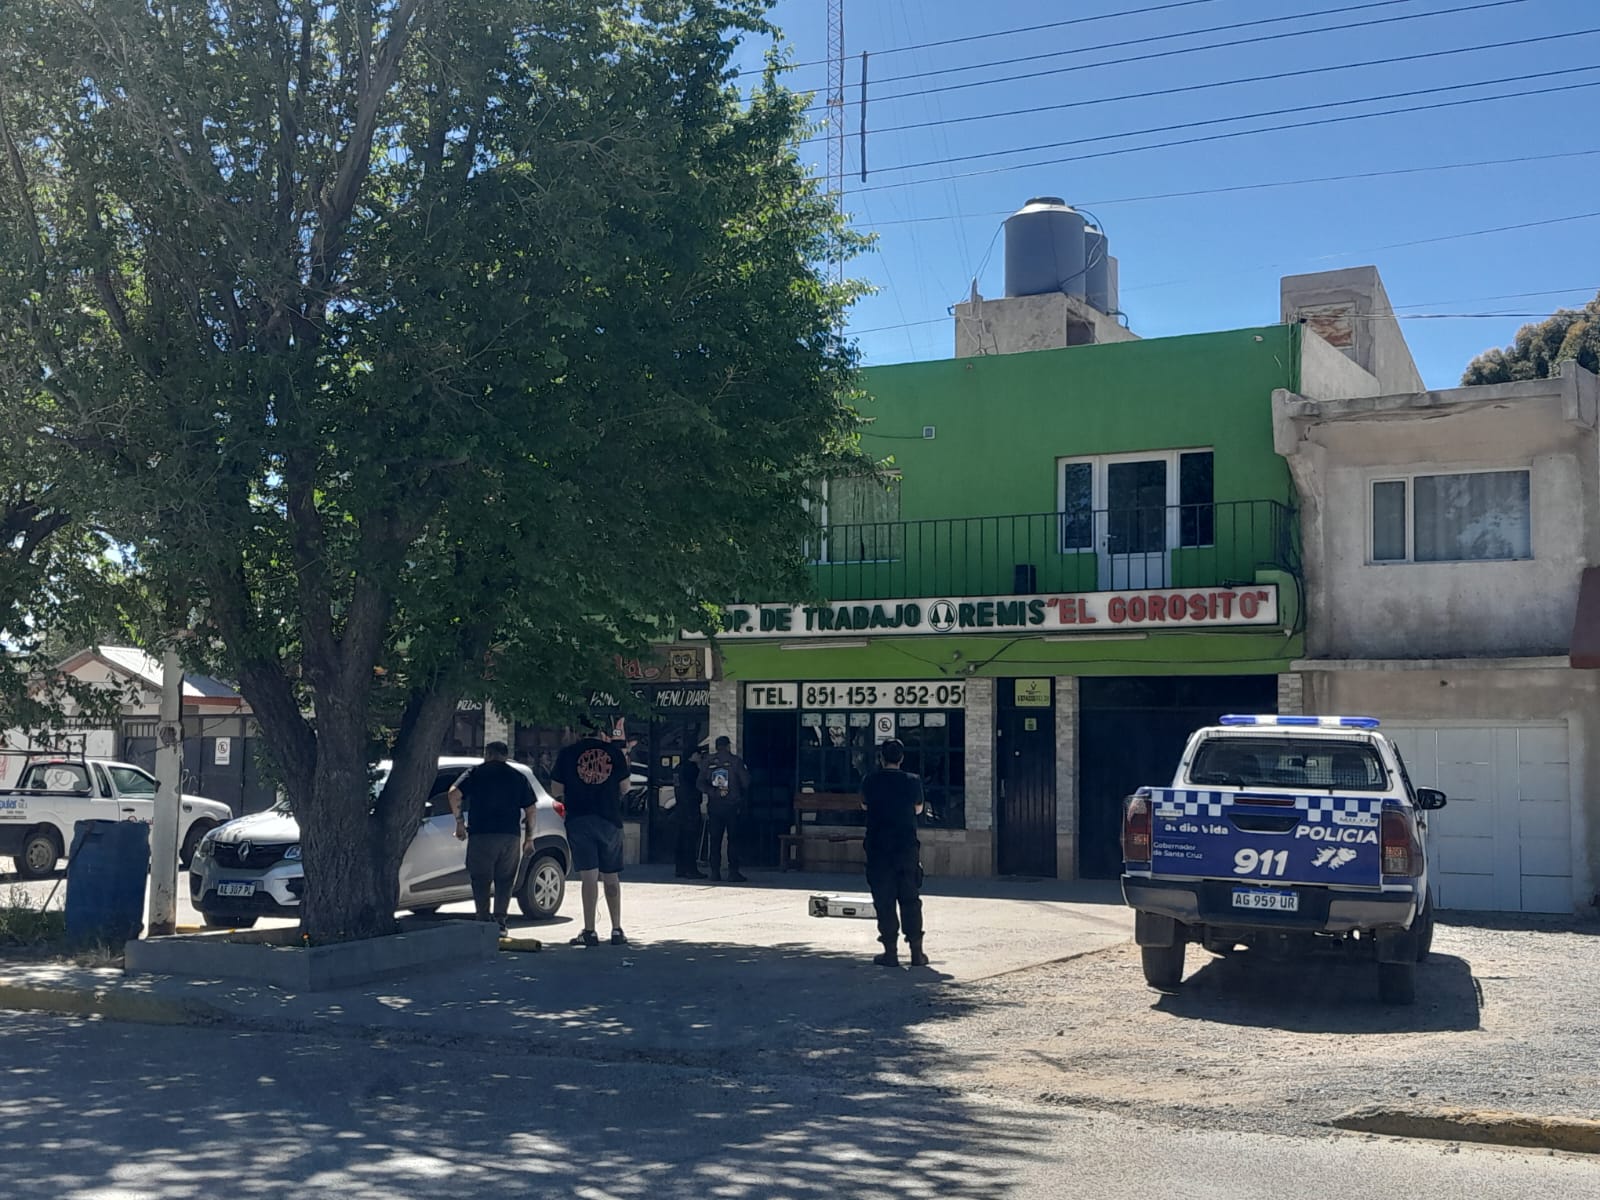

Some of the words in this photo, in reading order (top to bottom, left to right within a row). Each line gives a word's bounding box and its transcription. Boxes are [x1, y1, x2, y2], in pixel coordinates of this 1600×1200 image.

[759, 608, 792, 632] DE
[802, 604, 921, 632] TRABAJO
[957, 599, 1046, 628] REMIS
[752, 687, 793, 706] TEL.
[1294, 825, 1378, 844] POLICIA
[1153, 841, 1196, 851] Gobernador
[1163, 850, 1185, 858] Santa
[1232, 848, 1289, 877] 911
[1235, 893, 1250, 906] AG
[1254, 895, 1277, 907] 959
[1280, 897, 1295, 909] UR
